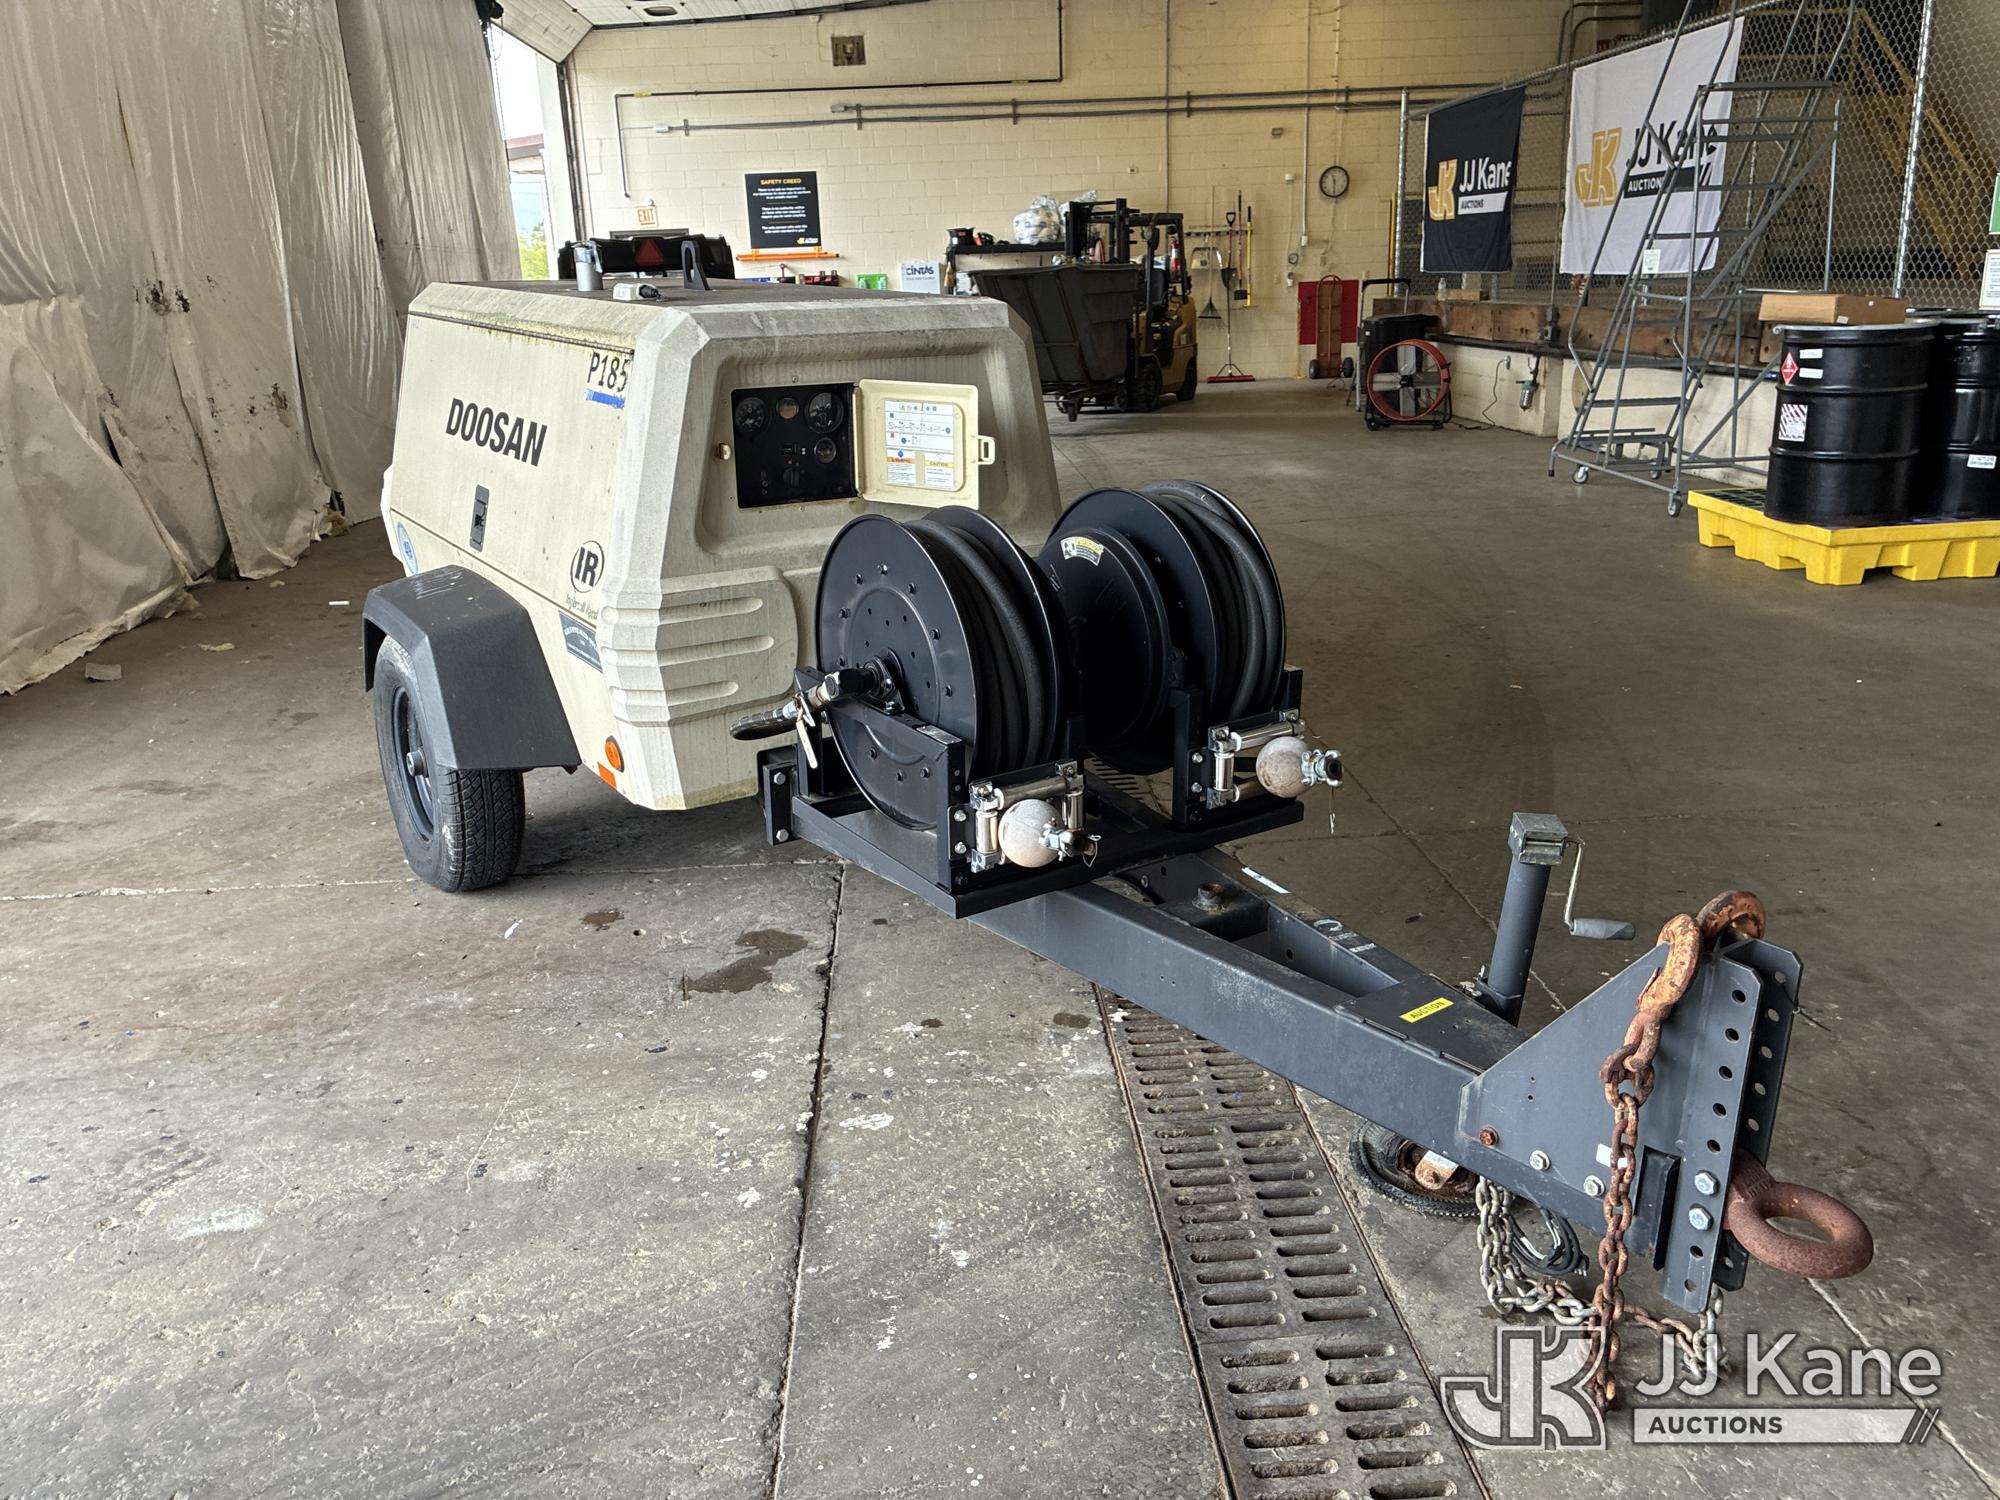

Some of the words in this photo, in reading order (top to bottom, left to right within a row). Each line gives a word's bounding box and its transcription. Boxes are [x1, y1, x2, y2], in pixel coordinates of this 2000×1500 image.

[1459, 160, 1476, 193] JJ
[1477, 156, 1512, 191] Kane
[1628, 177, 1666, 192] AUCTION
[1461, 199, 1484, 209] AUCTIONS
[906, 264, 935, 276] CINTAS
[586, 352, 631, 393] P185
[445, 397, 548, 467] DOOSAN
[574, 545, 599, 588] IR
[1410, 1001, 1446, 1019] AUCTION
